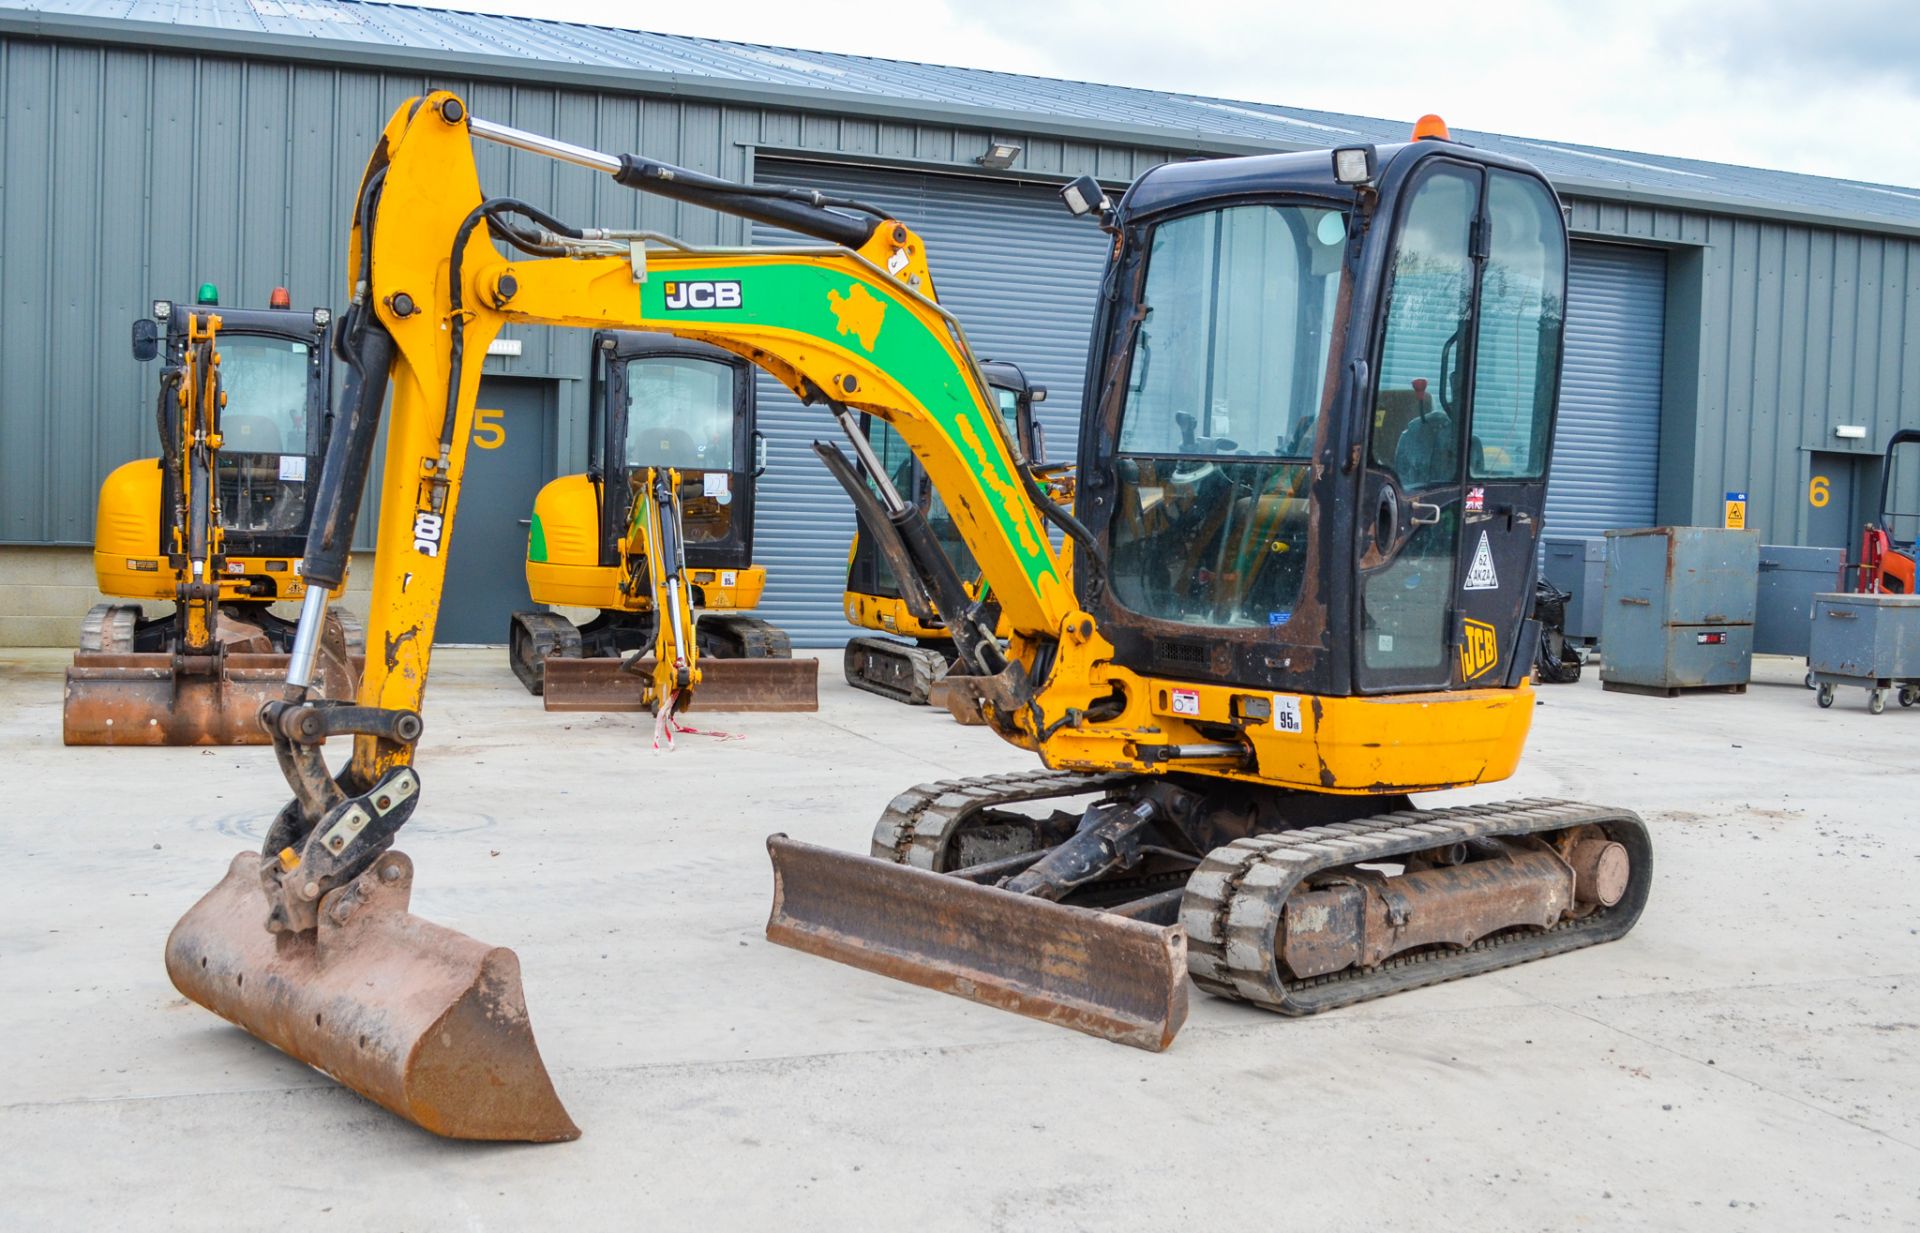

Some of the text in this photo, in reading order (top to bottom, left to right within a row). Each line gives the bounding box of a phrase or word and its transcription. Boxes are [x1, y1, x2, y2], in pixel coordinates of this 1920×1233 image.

[666, 282, 741, 308] JCB
[473, 409, 505, 449] 5
[1810, 476, 1829, 507] 6
[1464, 625, 1494, 676] JCB
